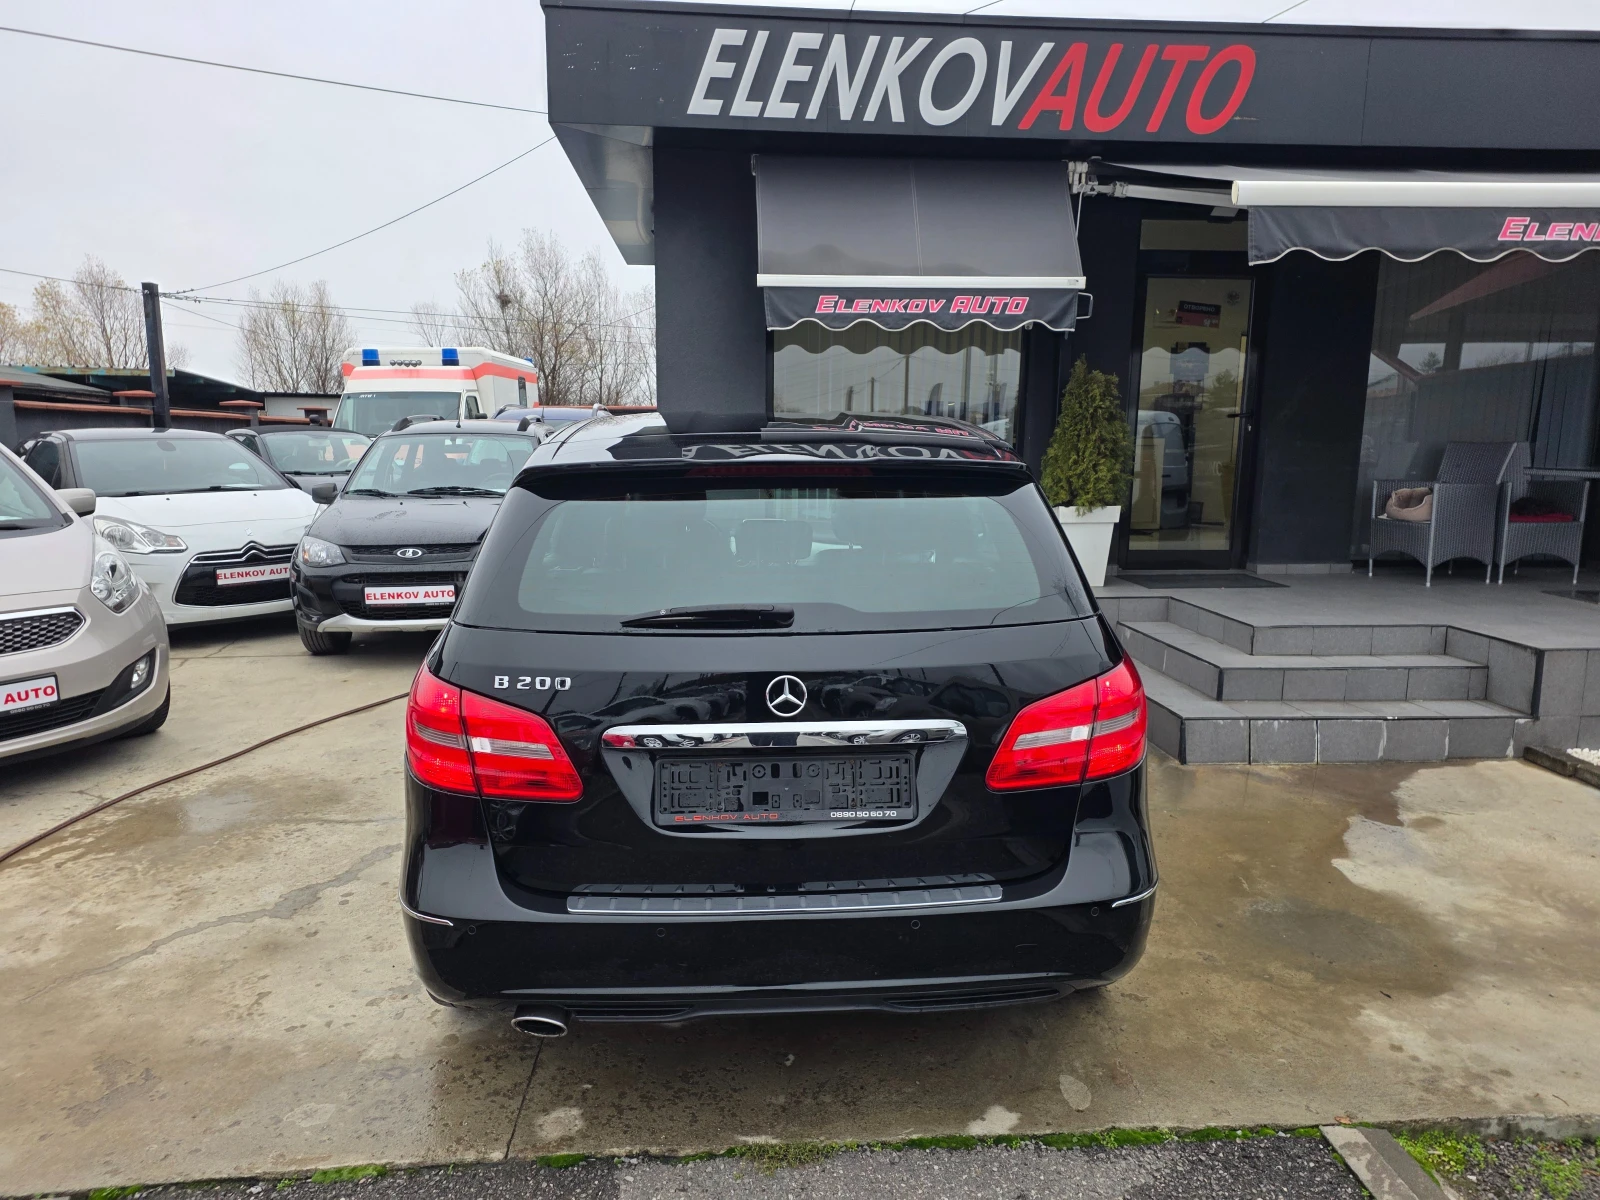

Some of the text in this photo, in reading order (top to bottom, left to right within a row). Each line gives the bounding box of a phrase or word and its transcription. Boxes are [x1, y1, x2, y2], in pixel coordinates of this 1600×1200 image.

[1497, 216, 1600, 241] ELEN
[951, 295, 1030, 315] AUTO
[216, 566, 291, 581] ELENKOV AUT
[366, 589, 455, 601] ELENKOV AUTO
[494, 675, 572, 691] B 200
[4, 685, 56, 705] AUTO
[674, 813, 778, 823] ELENKOV AUTO
